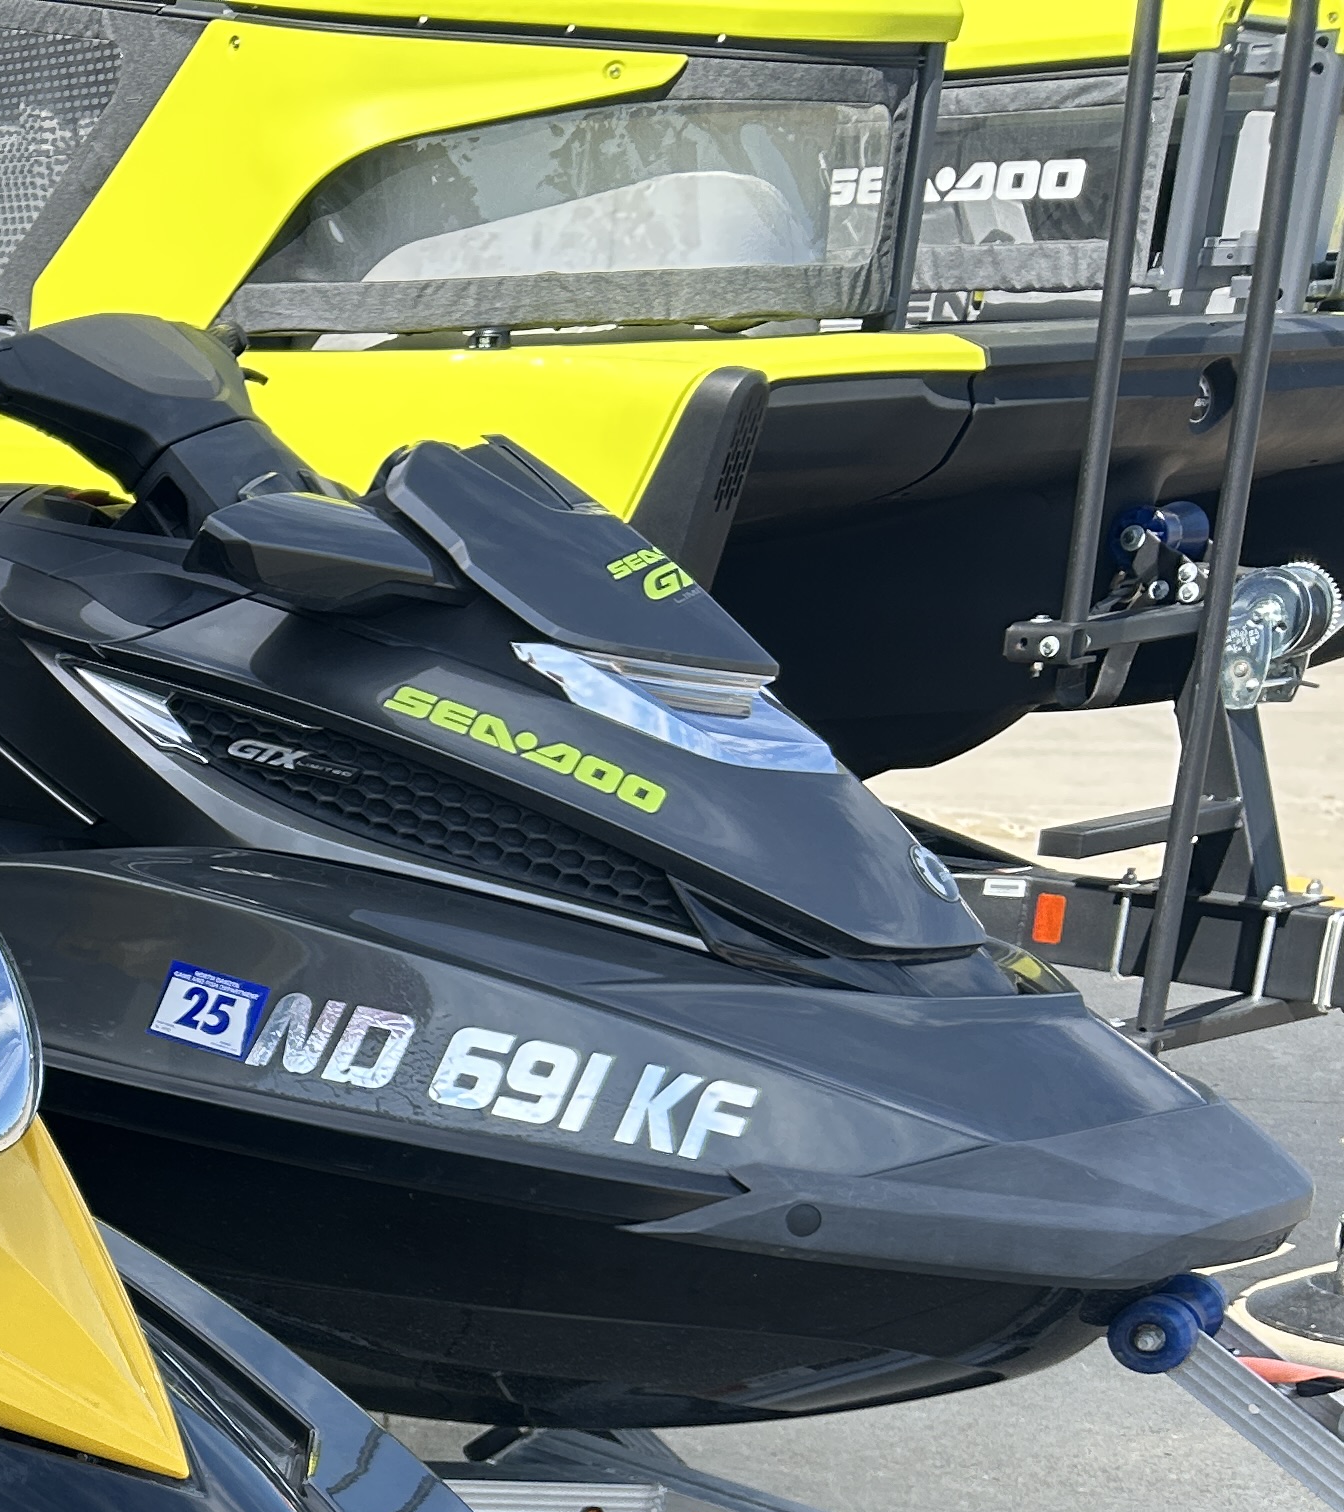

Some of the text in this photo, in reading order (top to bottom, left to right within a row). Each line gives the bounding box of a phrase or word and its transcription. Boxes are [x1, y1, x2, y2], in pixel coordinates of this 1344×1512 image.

[227, 738, 310, 770] GTX
[173, 986, 238, 1036] 25
[244, 992, 761, 1160] ND 691 KF
